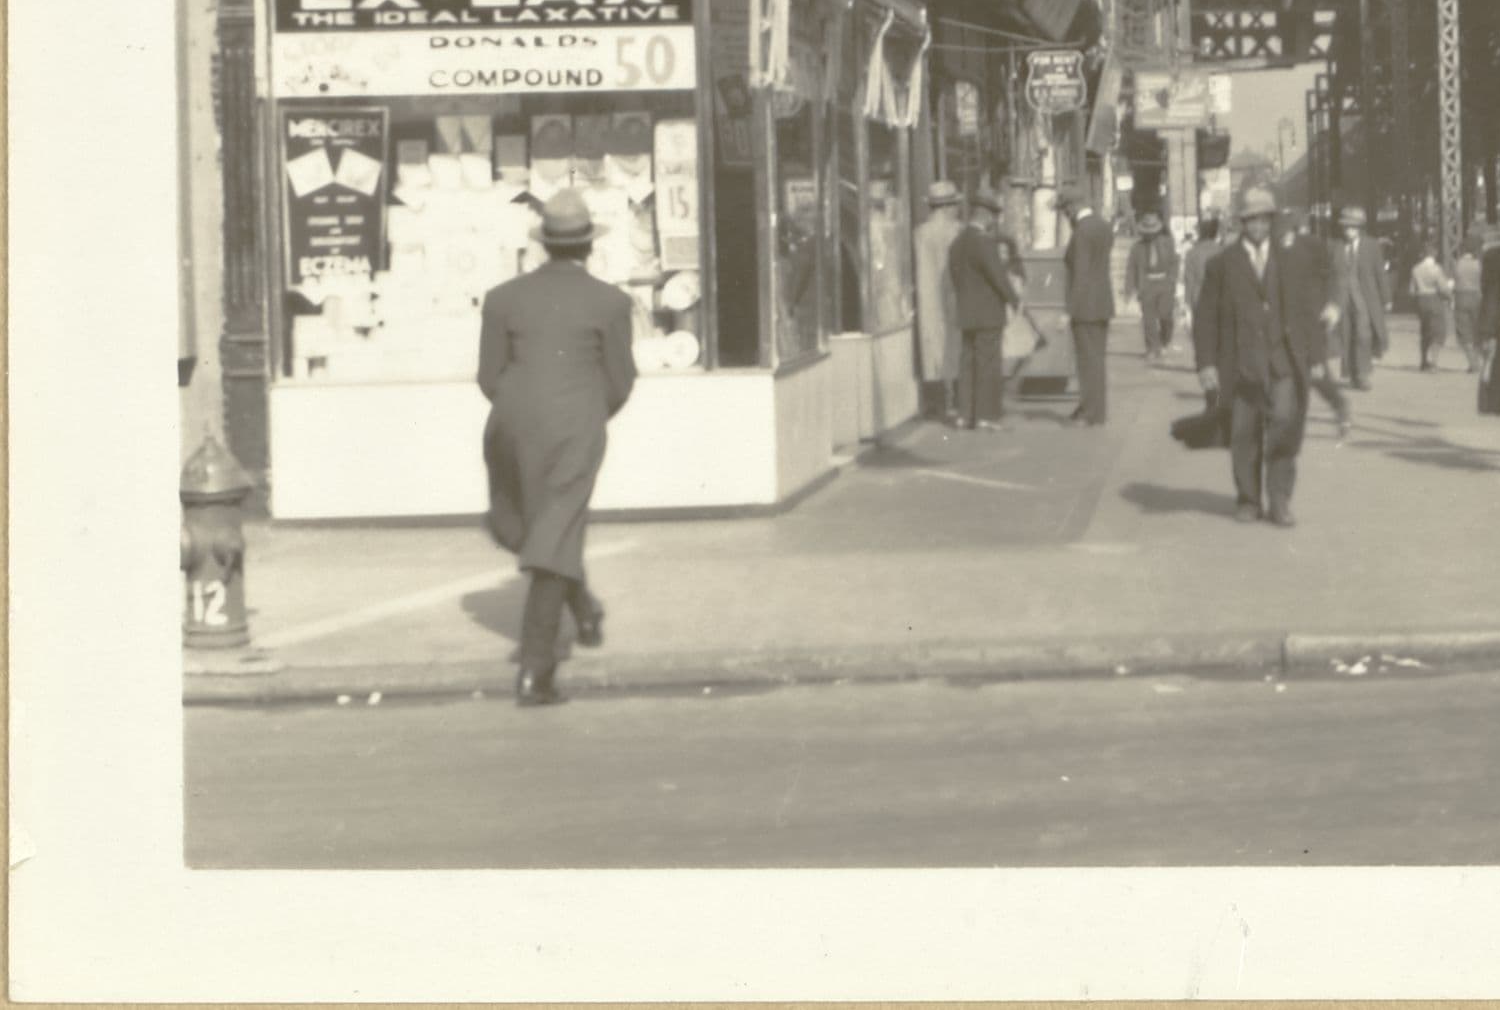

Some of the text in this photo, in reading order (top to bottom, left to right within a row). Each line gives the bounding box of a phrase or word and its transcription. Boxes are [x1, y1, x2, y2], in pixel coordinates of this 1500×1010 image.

[291, 5, 679, 26] THE IDEAL LAXATIVE
[428, 68, 604, 88] COMPOUND
[429, 34, 676, 88] DONALDS 50
[669, 185, 690, 220] 15
[192, 579, 229, 626] 12
